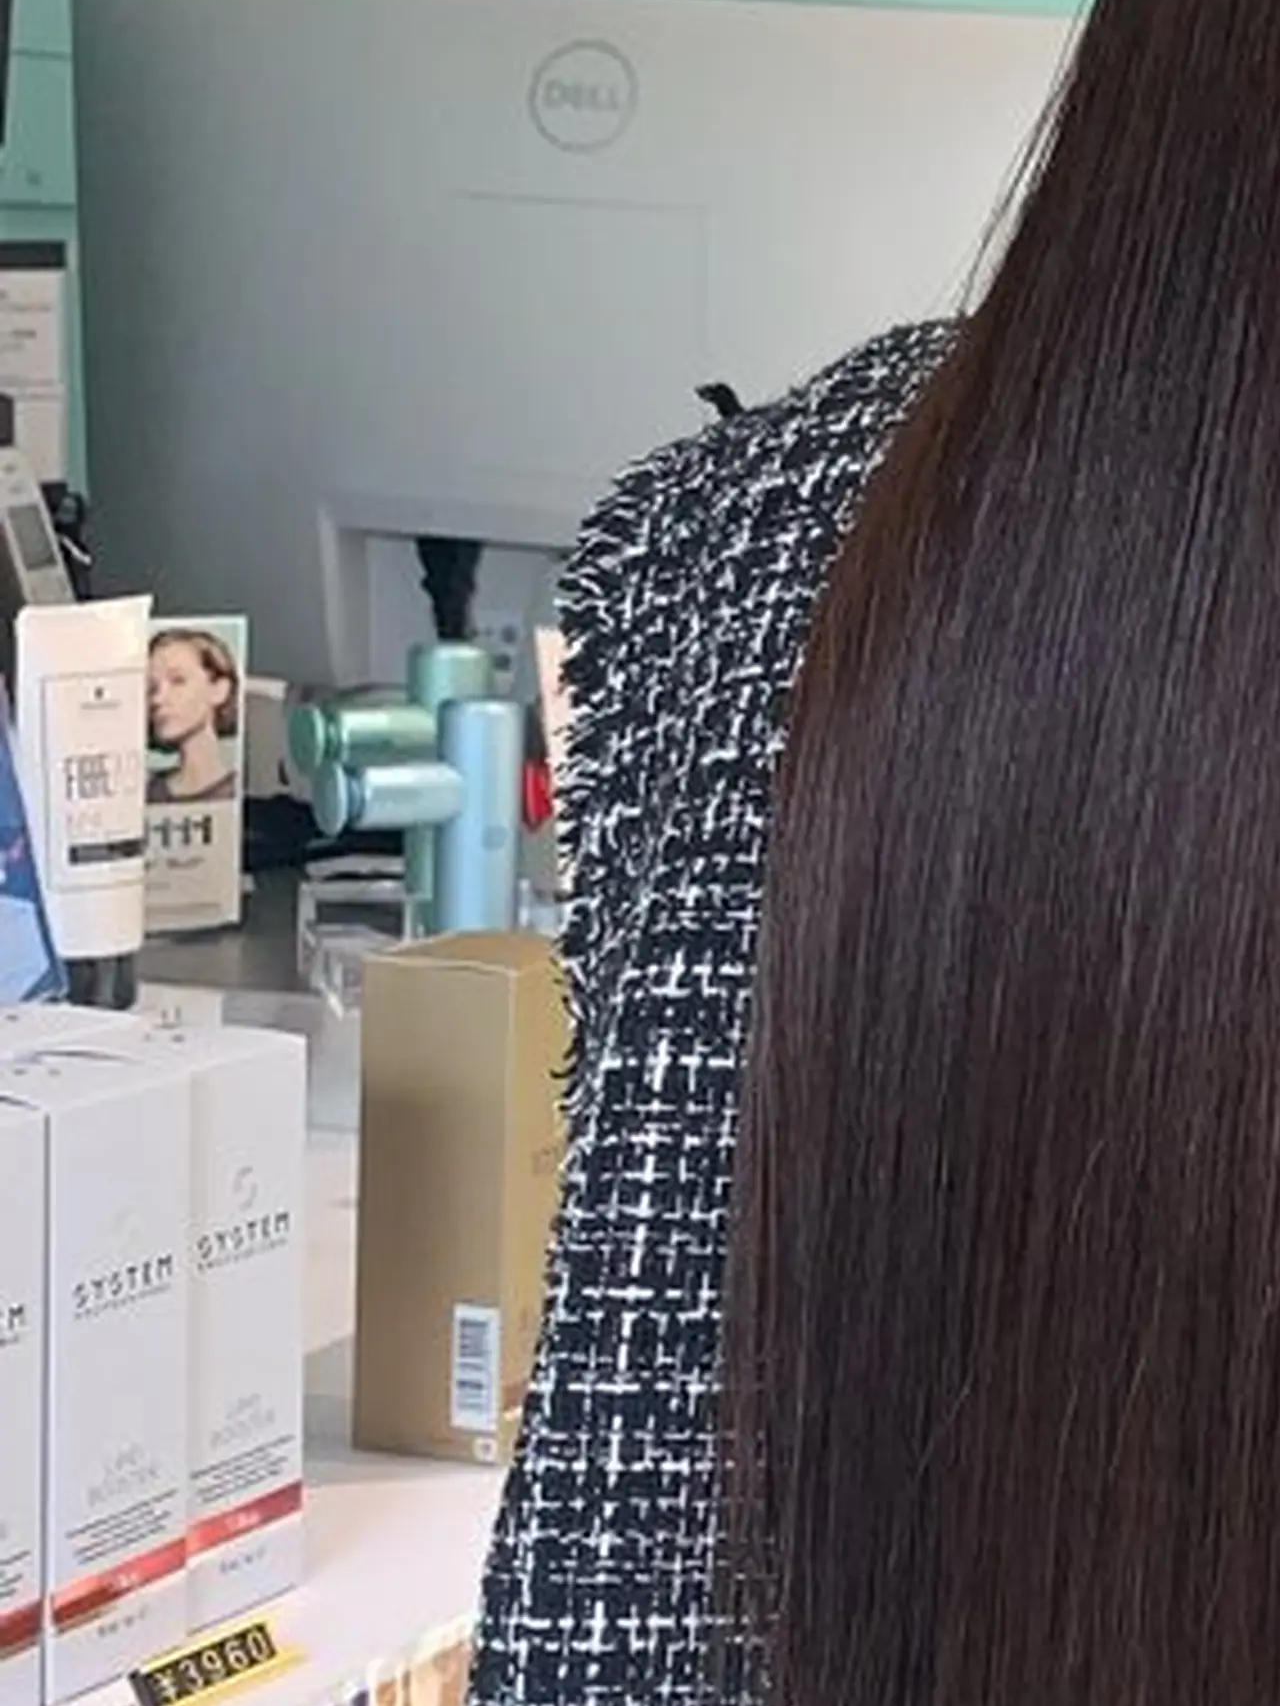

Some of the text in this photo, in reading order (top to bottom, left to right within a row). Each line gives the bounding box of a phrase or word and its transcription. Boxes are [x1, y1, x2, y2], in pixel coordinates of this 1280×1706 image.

[543, 78, 619, 111] DELL
[197, 1211, 290, 1259] SYSTEM
[73, 1254, 173, 1309] SYSTEM
[152, 1629, 270, 1702] ¥3960
